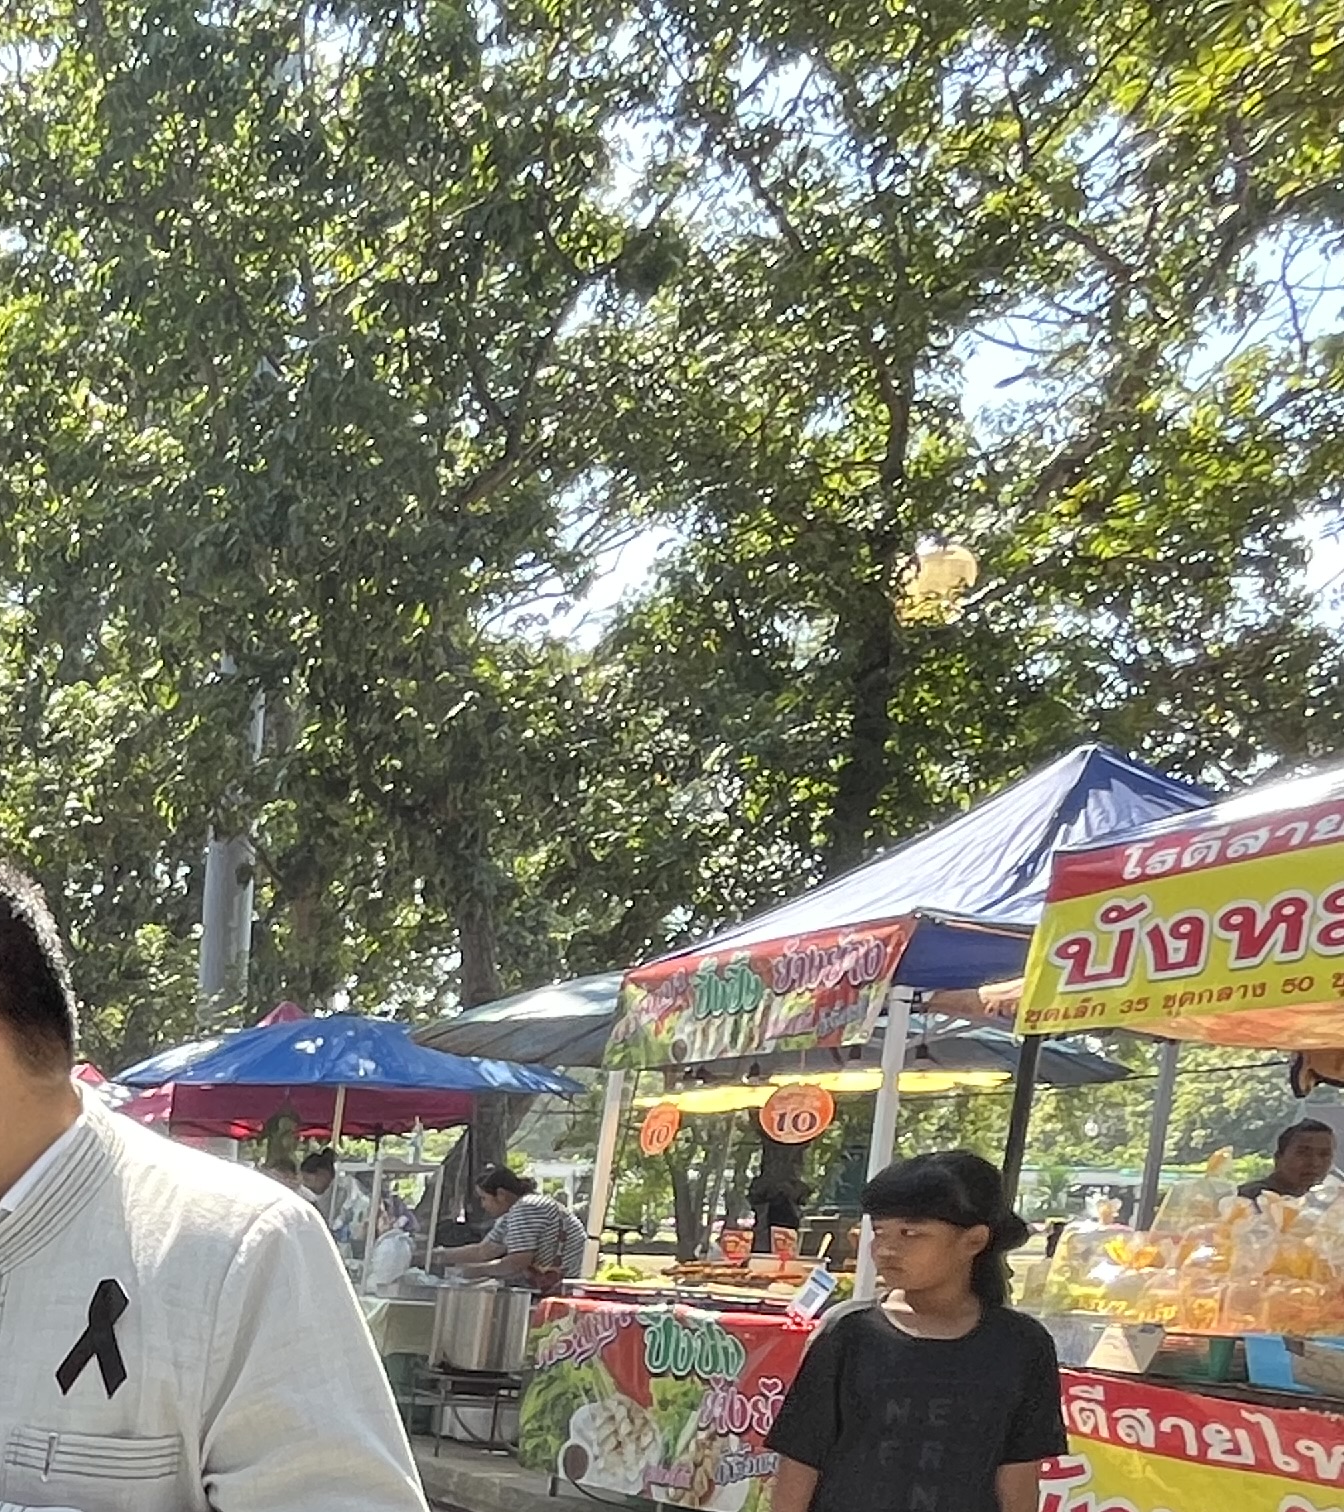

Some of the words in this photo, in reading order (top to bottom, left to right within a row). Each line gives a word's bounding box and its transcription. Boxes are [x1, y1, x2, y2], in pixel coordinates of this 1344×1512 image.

[1119, 999, 1151, 1014] 35
[1280, 975, 1315, 995] 50
[773, 1108, 819, 1134] 10
[1062, 1384, 1344, 1479] ตีสายไห
